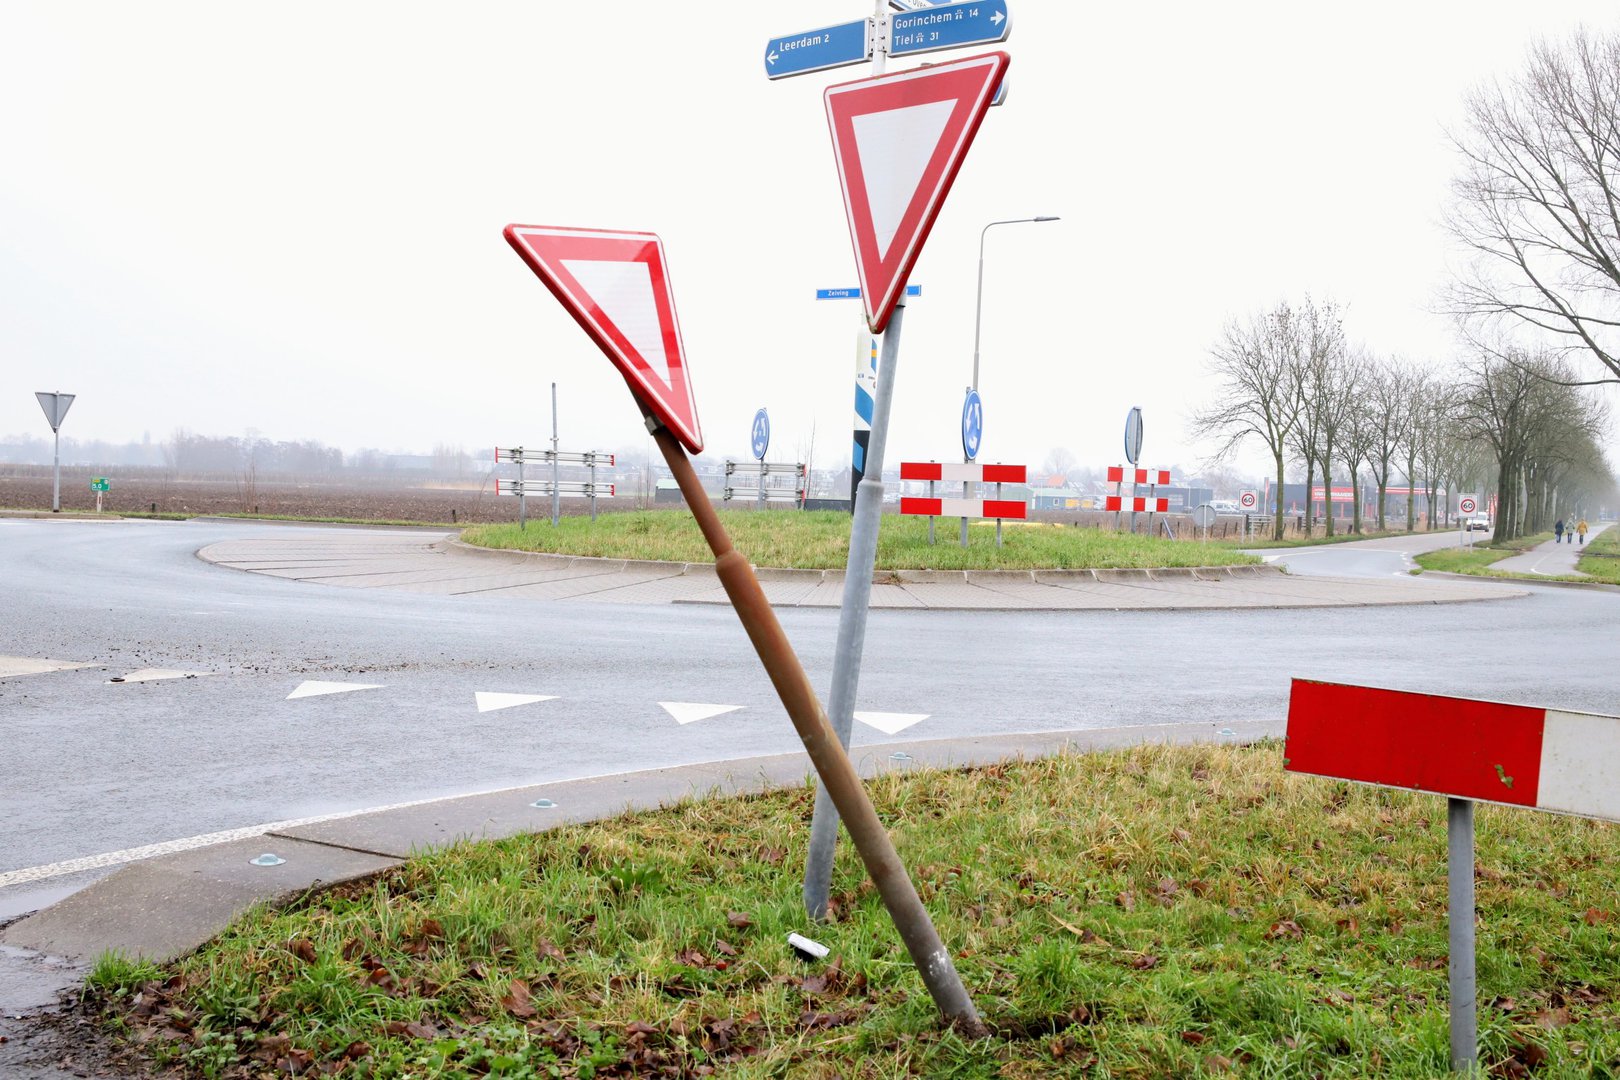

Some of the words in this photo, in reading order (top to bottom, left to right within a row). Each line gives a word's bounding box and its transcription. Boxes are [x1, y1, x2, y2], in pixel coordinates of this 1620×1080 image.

[895, 12, 952, 29] Gorinchem
[969, 8, 979, 18] 14
[780, 36, 821, 52] Leerdam
[824, 34, 830, 43] 2
[895, 34, 914, 46] Tiel
[929, 32, 939, 41] 31
